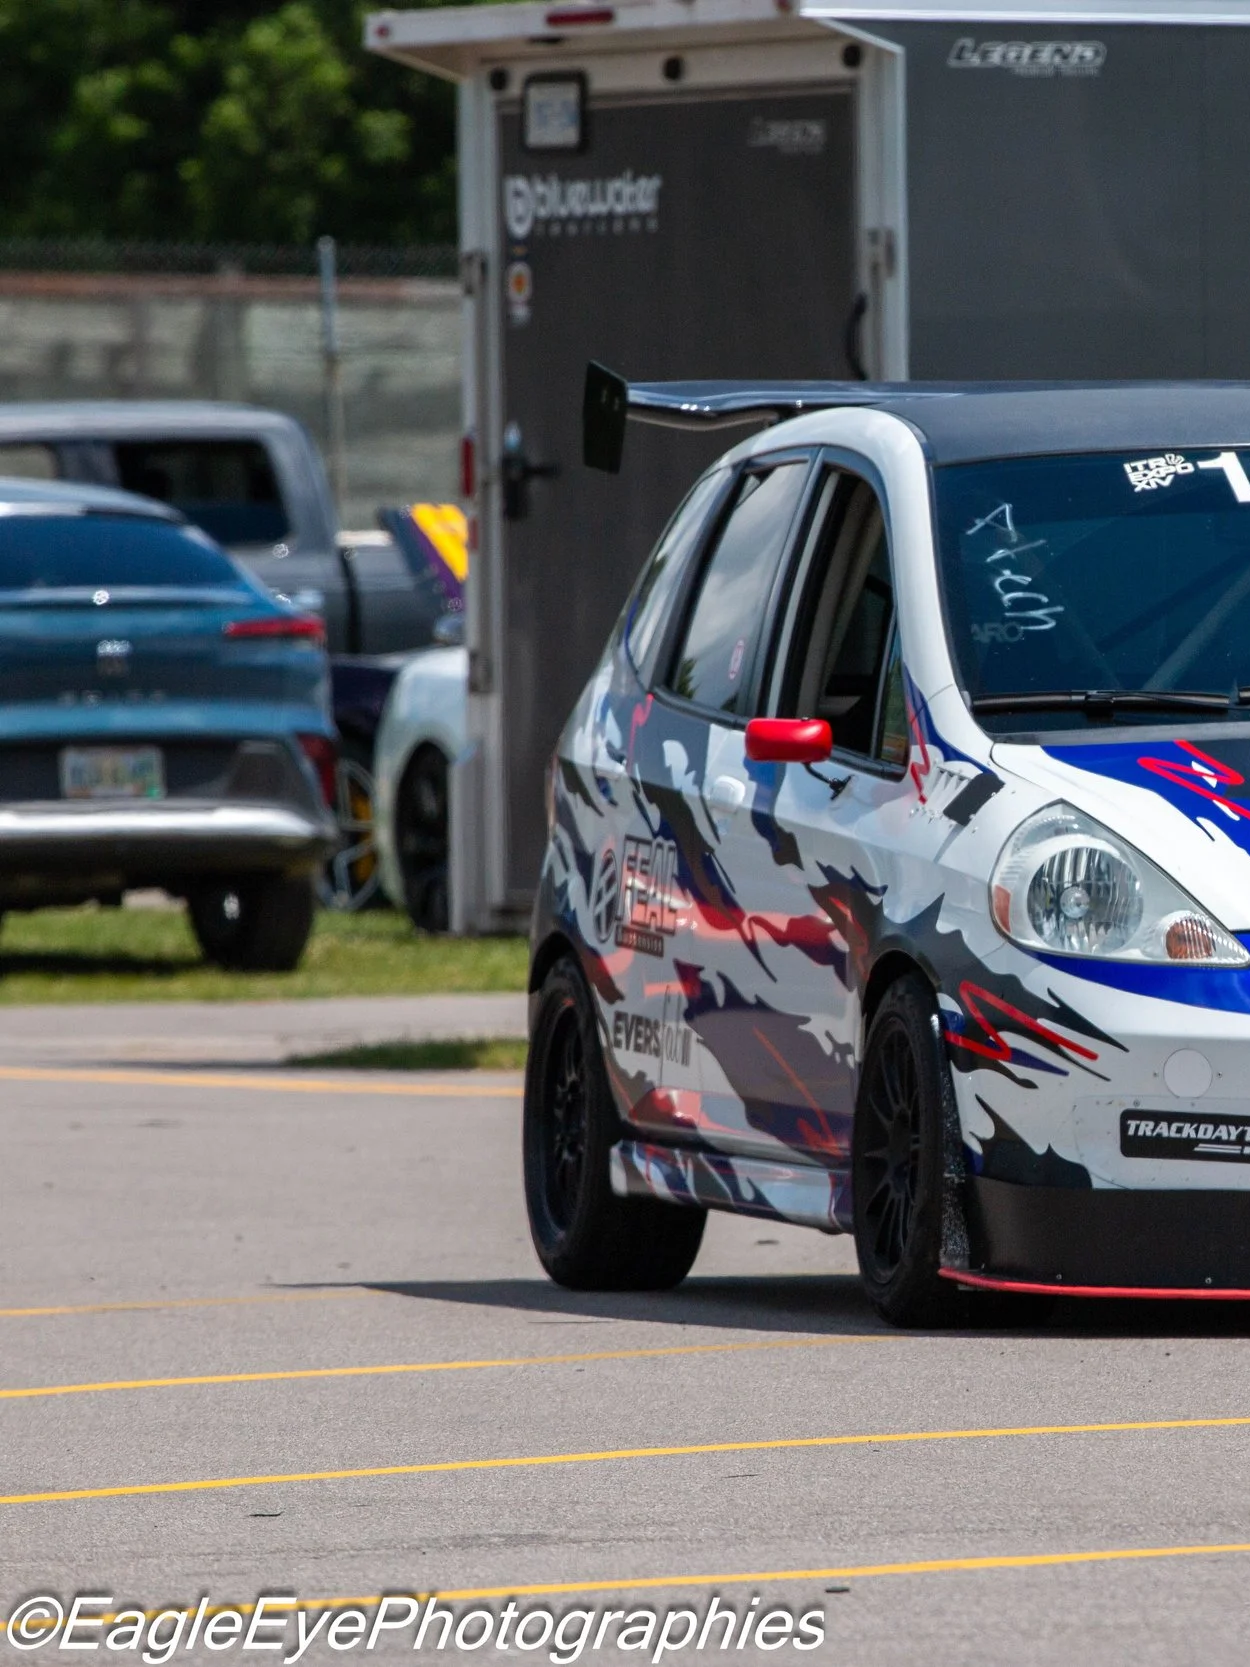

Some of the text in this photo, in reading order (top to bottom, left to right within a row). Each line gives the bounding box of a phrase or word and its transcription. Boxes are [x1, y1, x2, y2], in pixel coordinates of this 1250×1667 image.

[1123, 457, 1167, 473] ITR
[1127, 461, 1195, 482] EXPO
[1134, 475, 1175, 492] XIV
